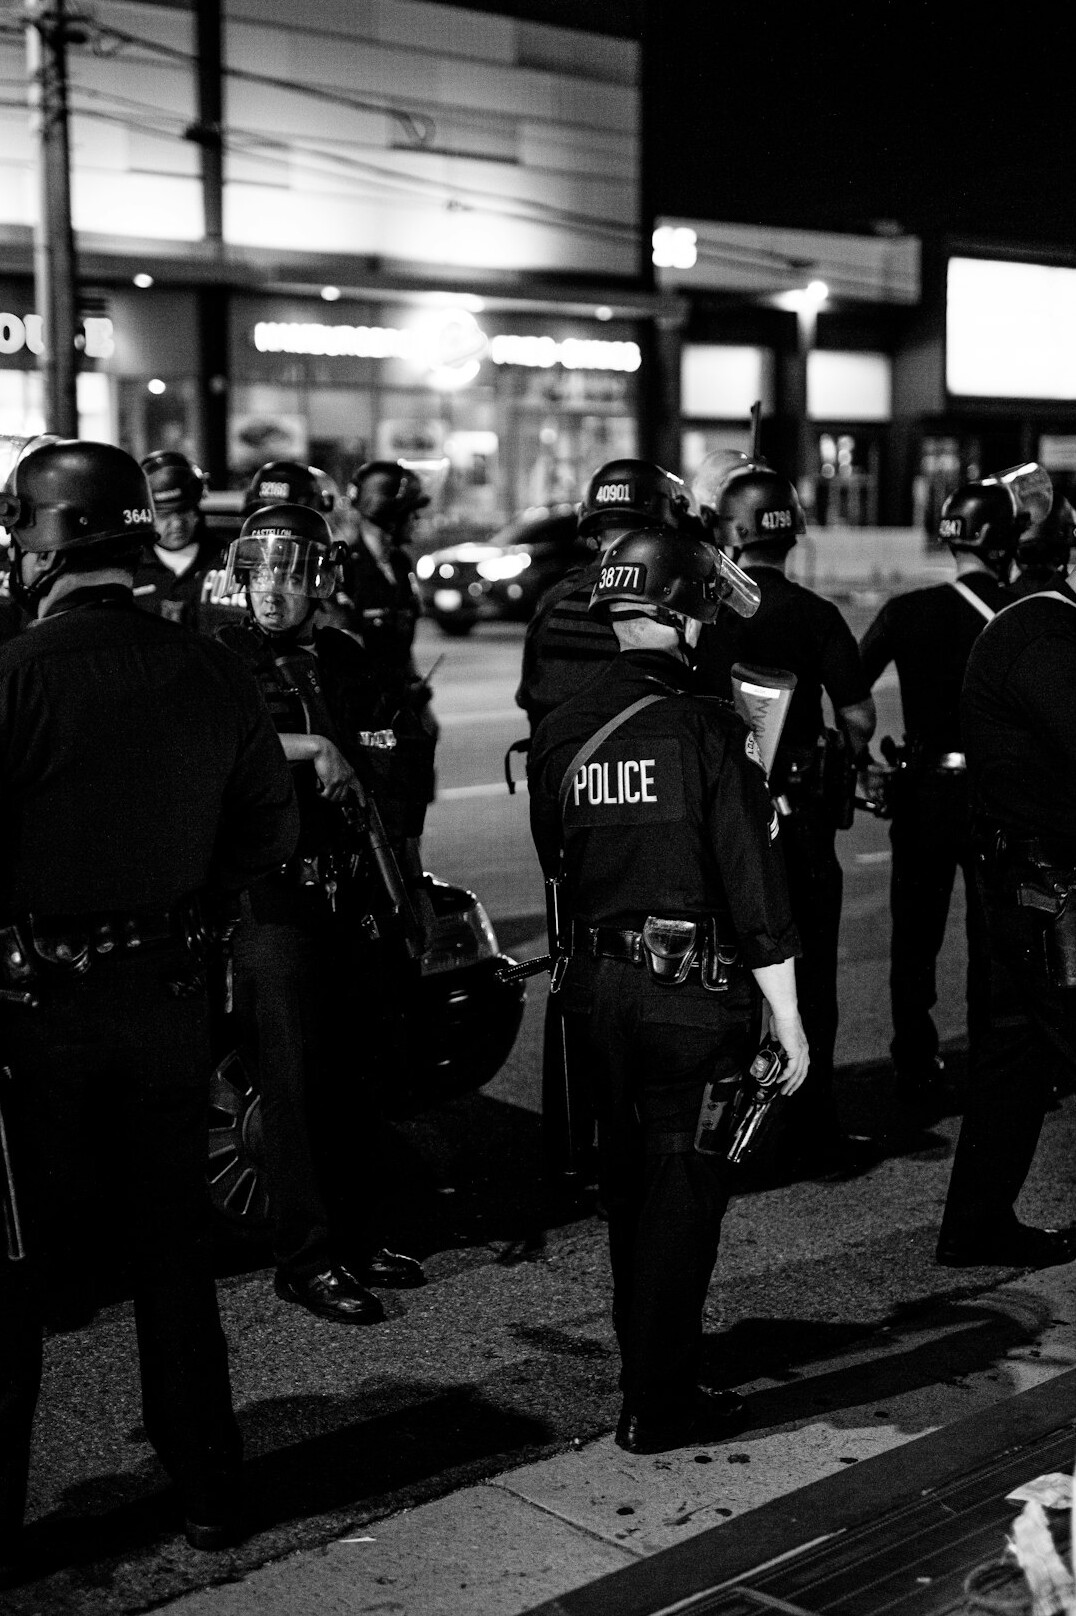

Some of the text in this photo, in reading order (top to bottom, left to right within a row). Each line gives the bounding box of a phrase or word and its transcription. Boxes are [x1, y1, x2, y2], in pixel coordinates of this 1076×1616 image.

[596, 484, 630, 502] 40901
[599, 566, 640, 588] 38771
[573, 759, 658, 806] POLICE
